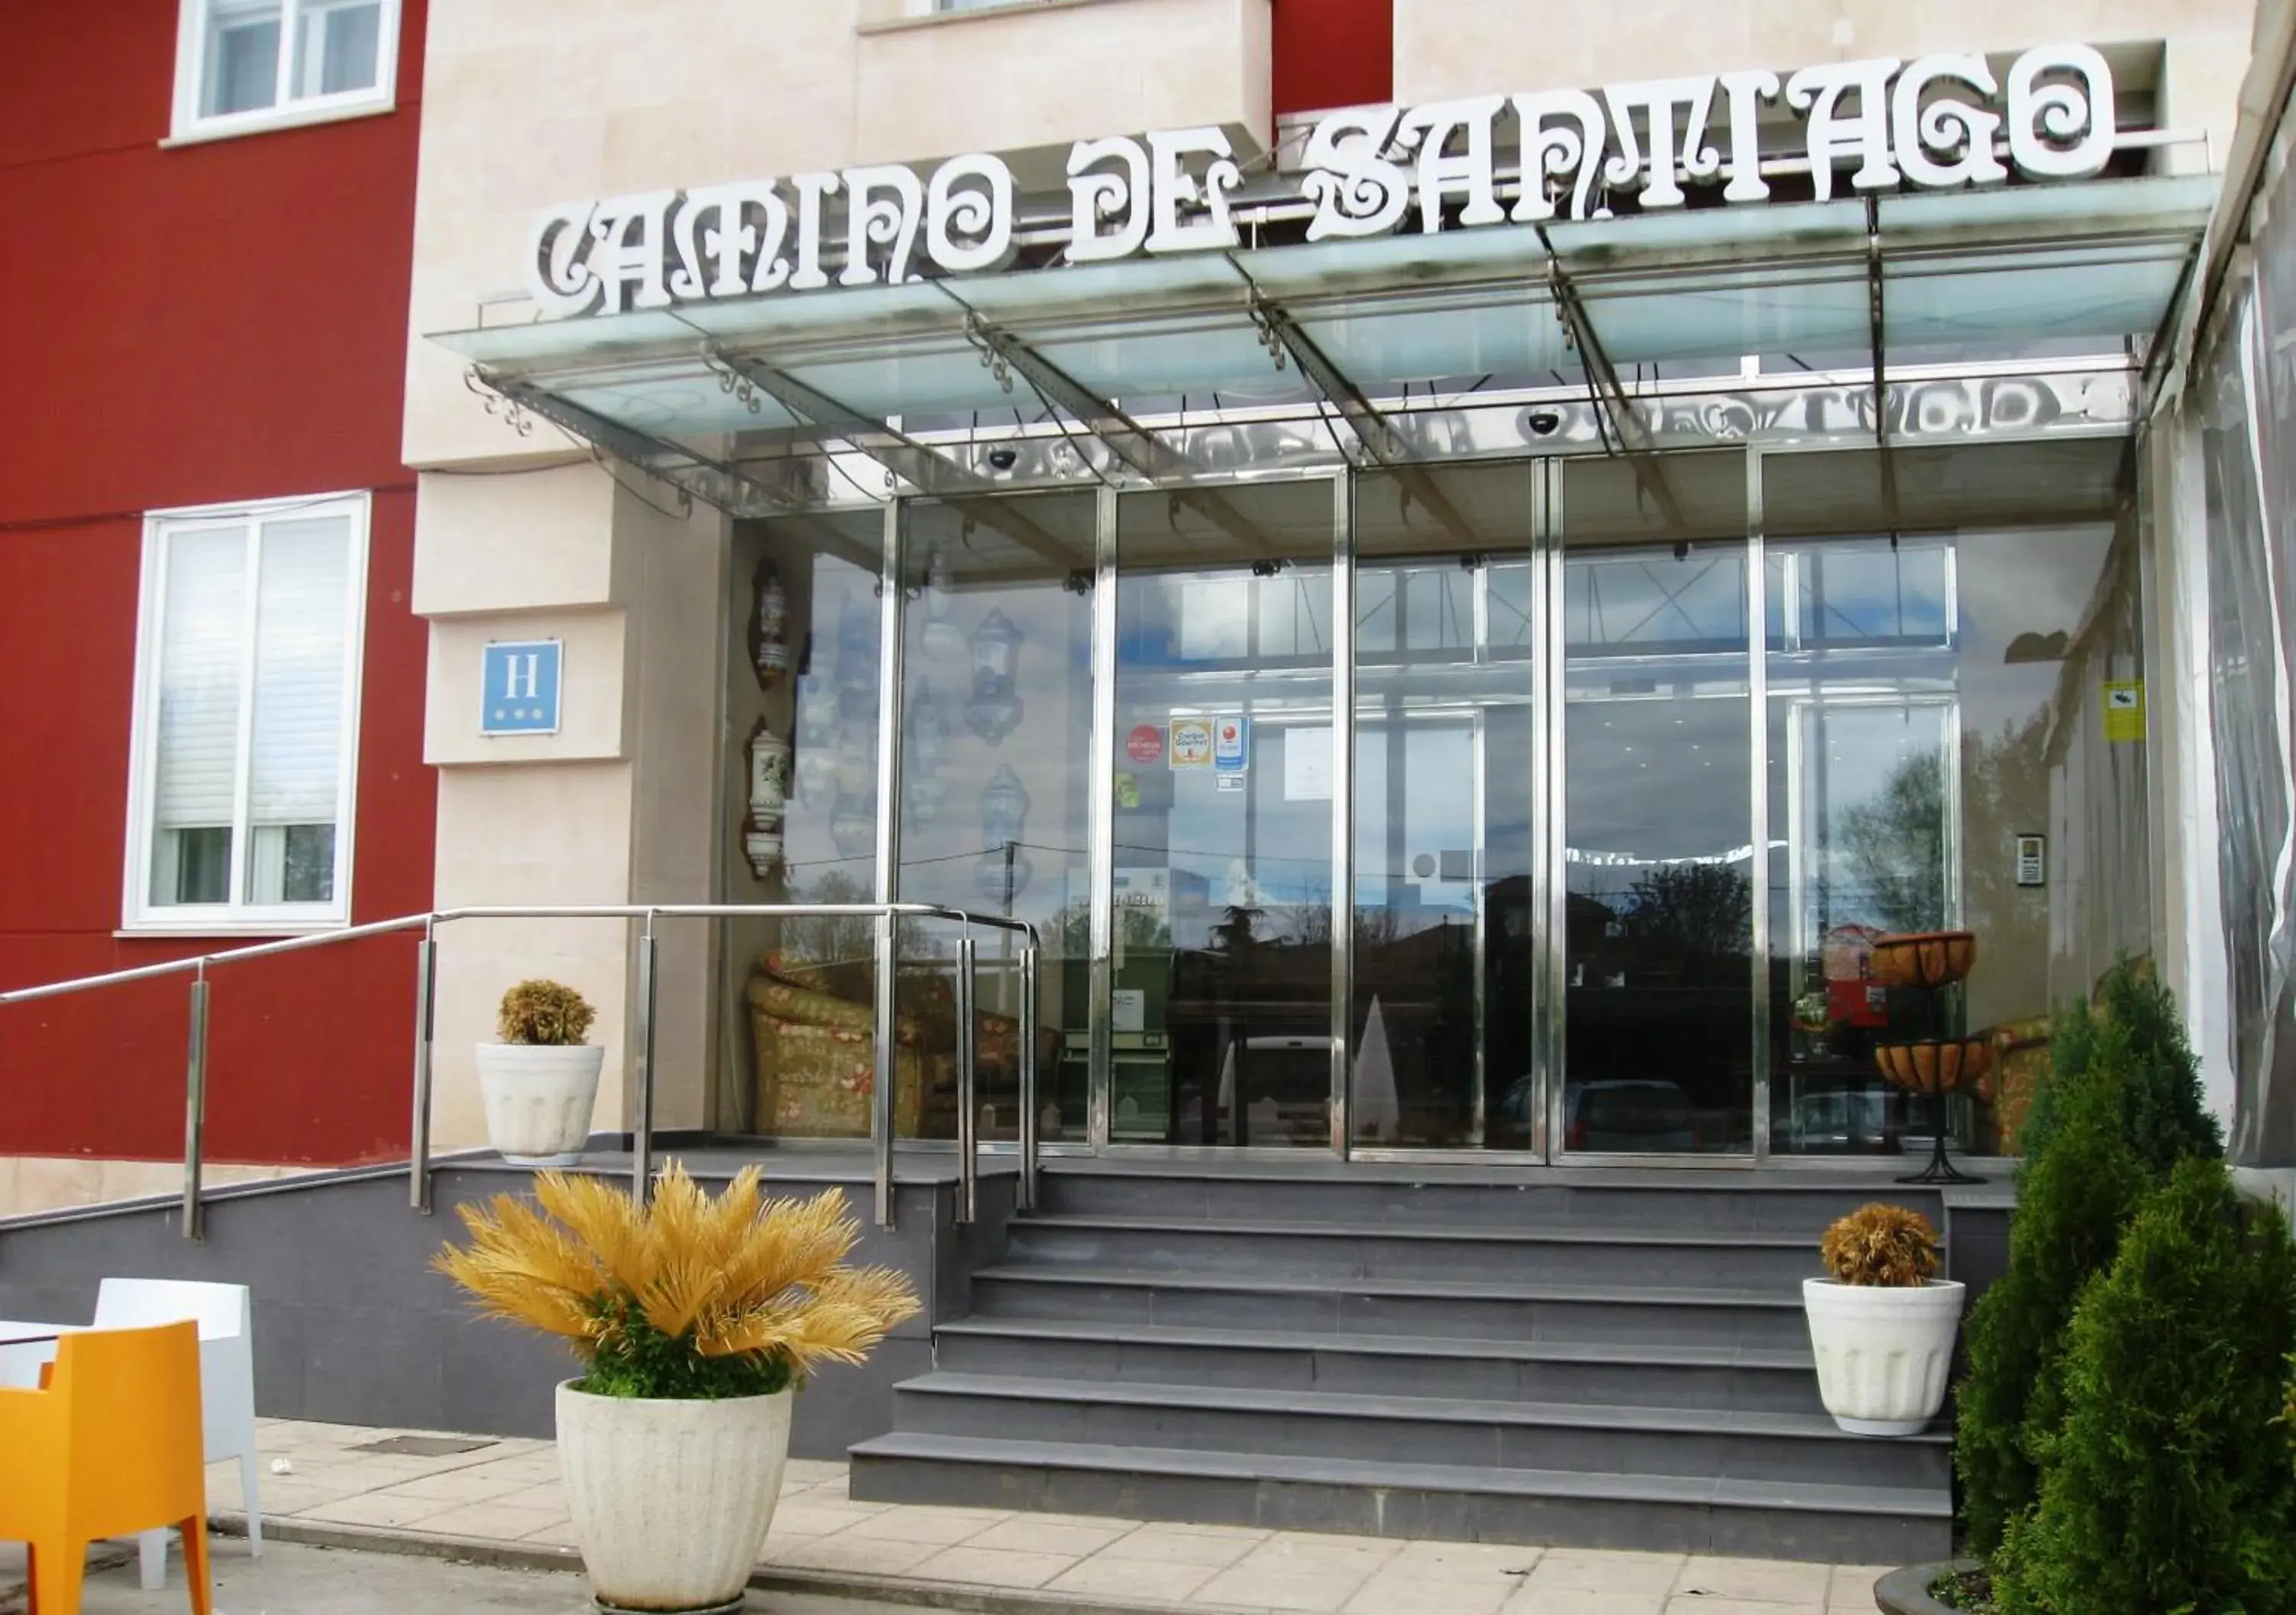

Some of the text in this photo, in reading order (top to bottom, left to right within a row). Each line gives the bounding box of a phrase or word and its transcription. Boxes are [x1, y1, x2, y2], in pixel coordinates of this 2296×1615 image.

[530, 44, 2115, 317] CAMINO DE SANTIAGO
[503, 654, 539, 698] H
